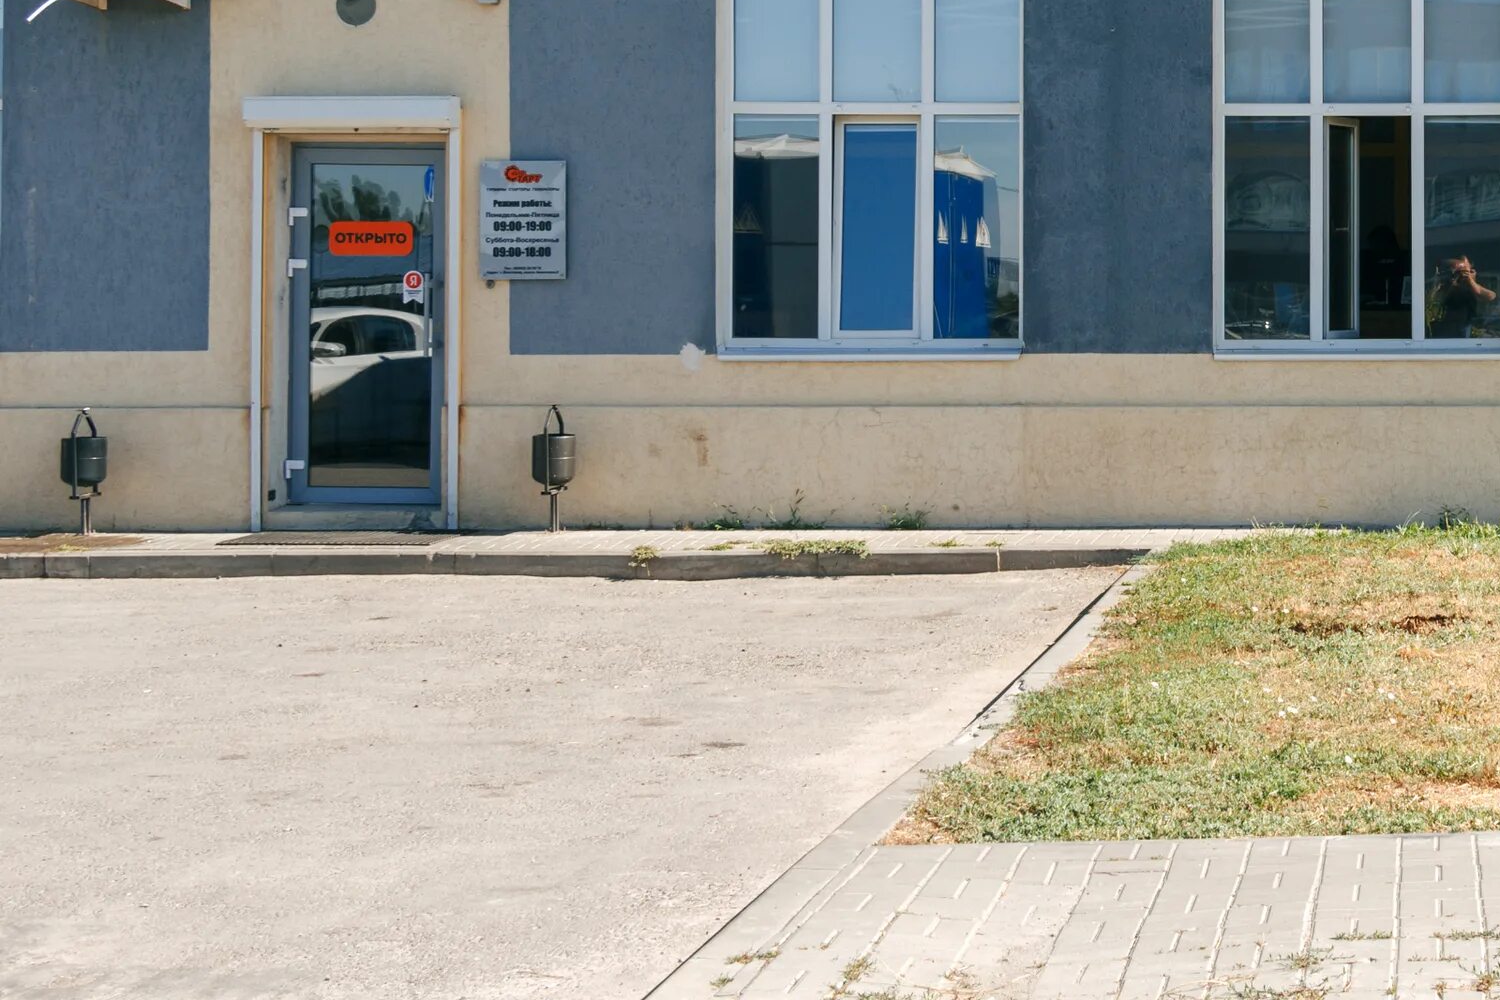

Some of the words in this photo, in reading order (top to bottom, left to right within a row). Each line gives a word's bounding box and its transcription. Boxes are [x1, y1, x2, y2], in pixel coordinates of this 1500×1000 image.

[493, 221, 552, 231] 09:00-19:00
[335, 232, 407, 244] ОТКРЫТО
[493, 247, 551, 257] 09:00-18:00
